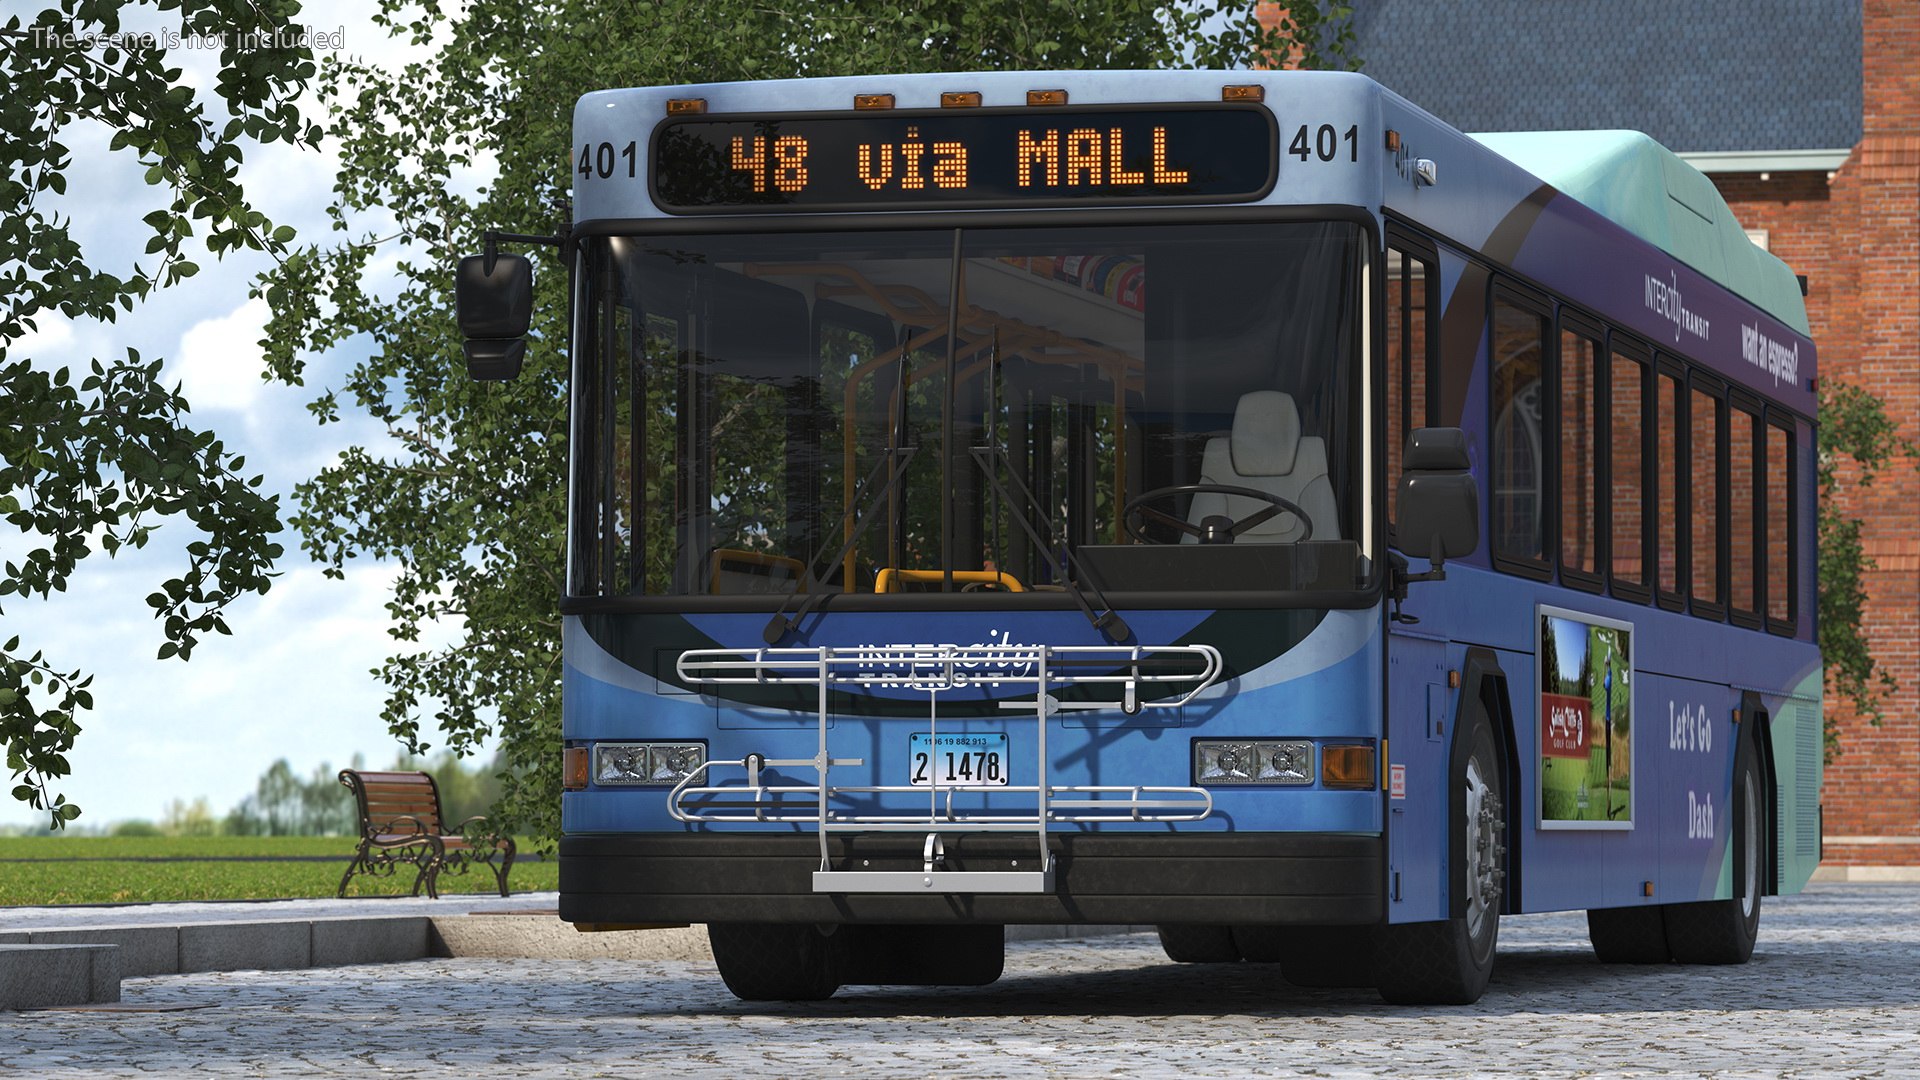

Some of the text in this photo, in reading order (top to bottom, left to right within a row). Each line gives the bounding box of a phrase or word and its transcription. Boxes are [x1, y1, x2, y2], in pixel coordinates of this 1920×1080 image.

[578, 140, 637, 180] 401
[731, 126, 1188, 193] 48 via MALL
[1288, 124, 1359, 163] 401
[1741, 320, 1759, 367] want
[1759, 332, 1768, 372] an
[924, 737, 943, 746] 116
[1669, 700, 1712, 753] Let's Go
[915, 752, 1000, 781] 2 1478
[1688, 790, 1714, 839] Dash
